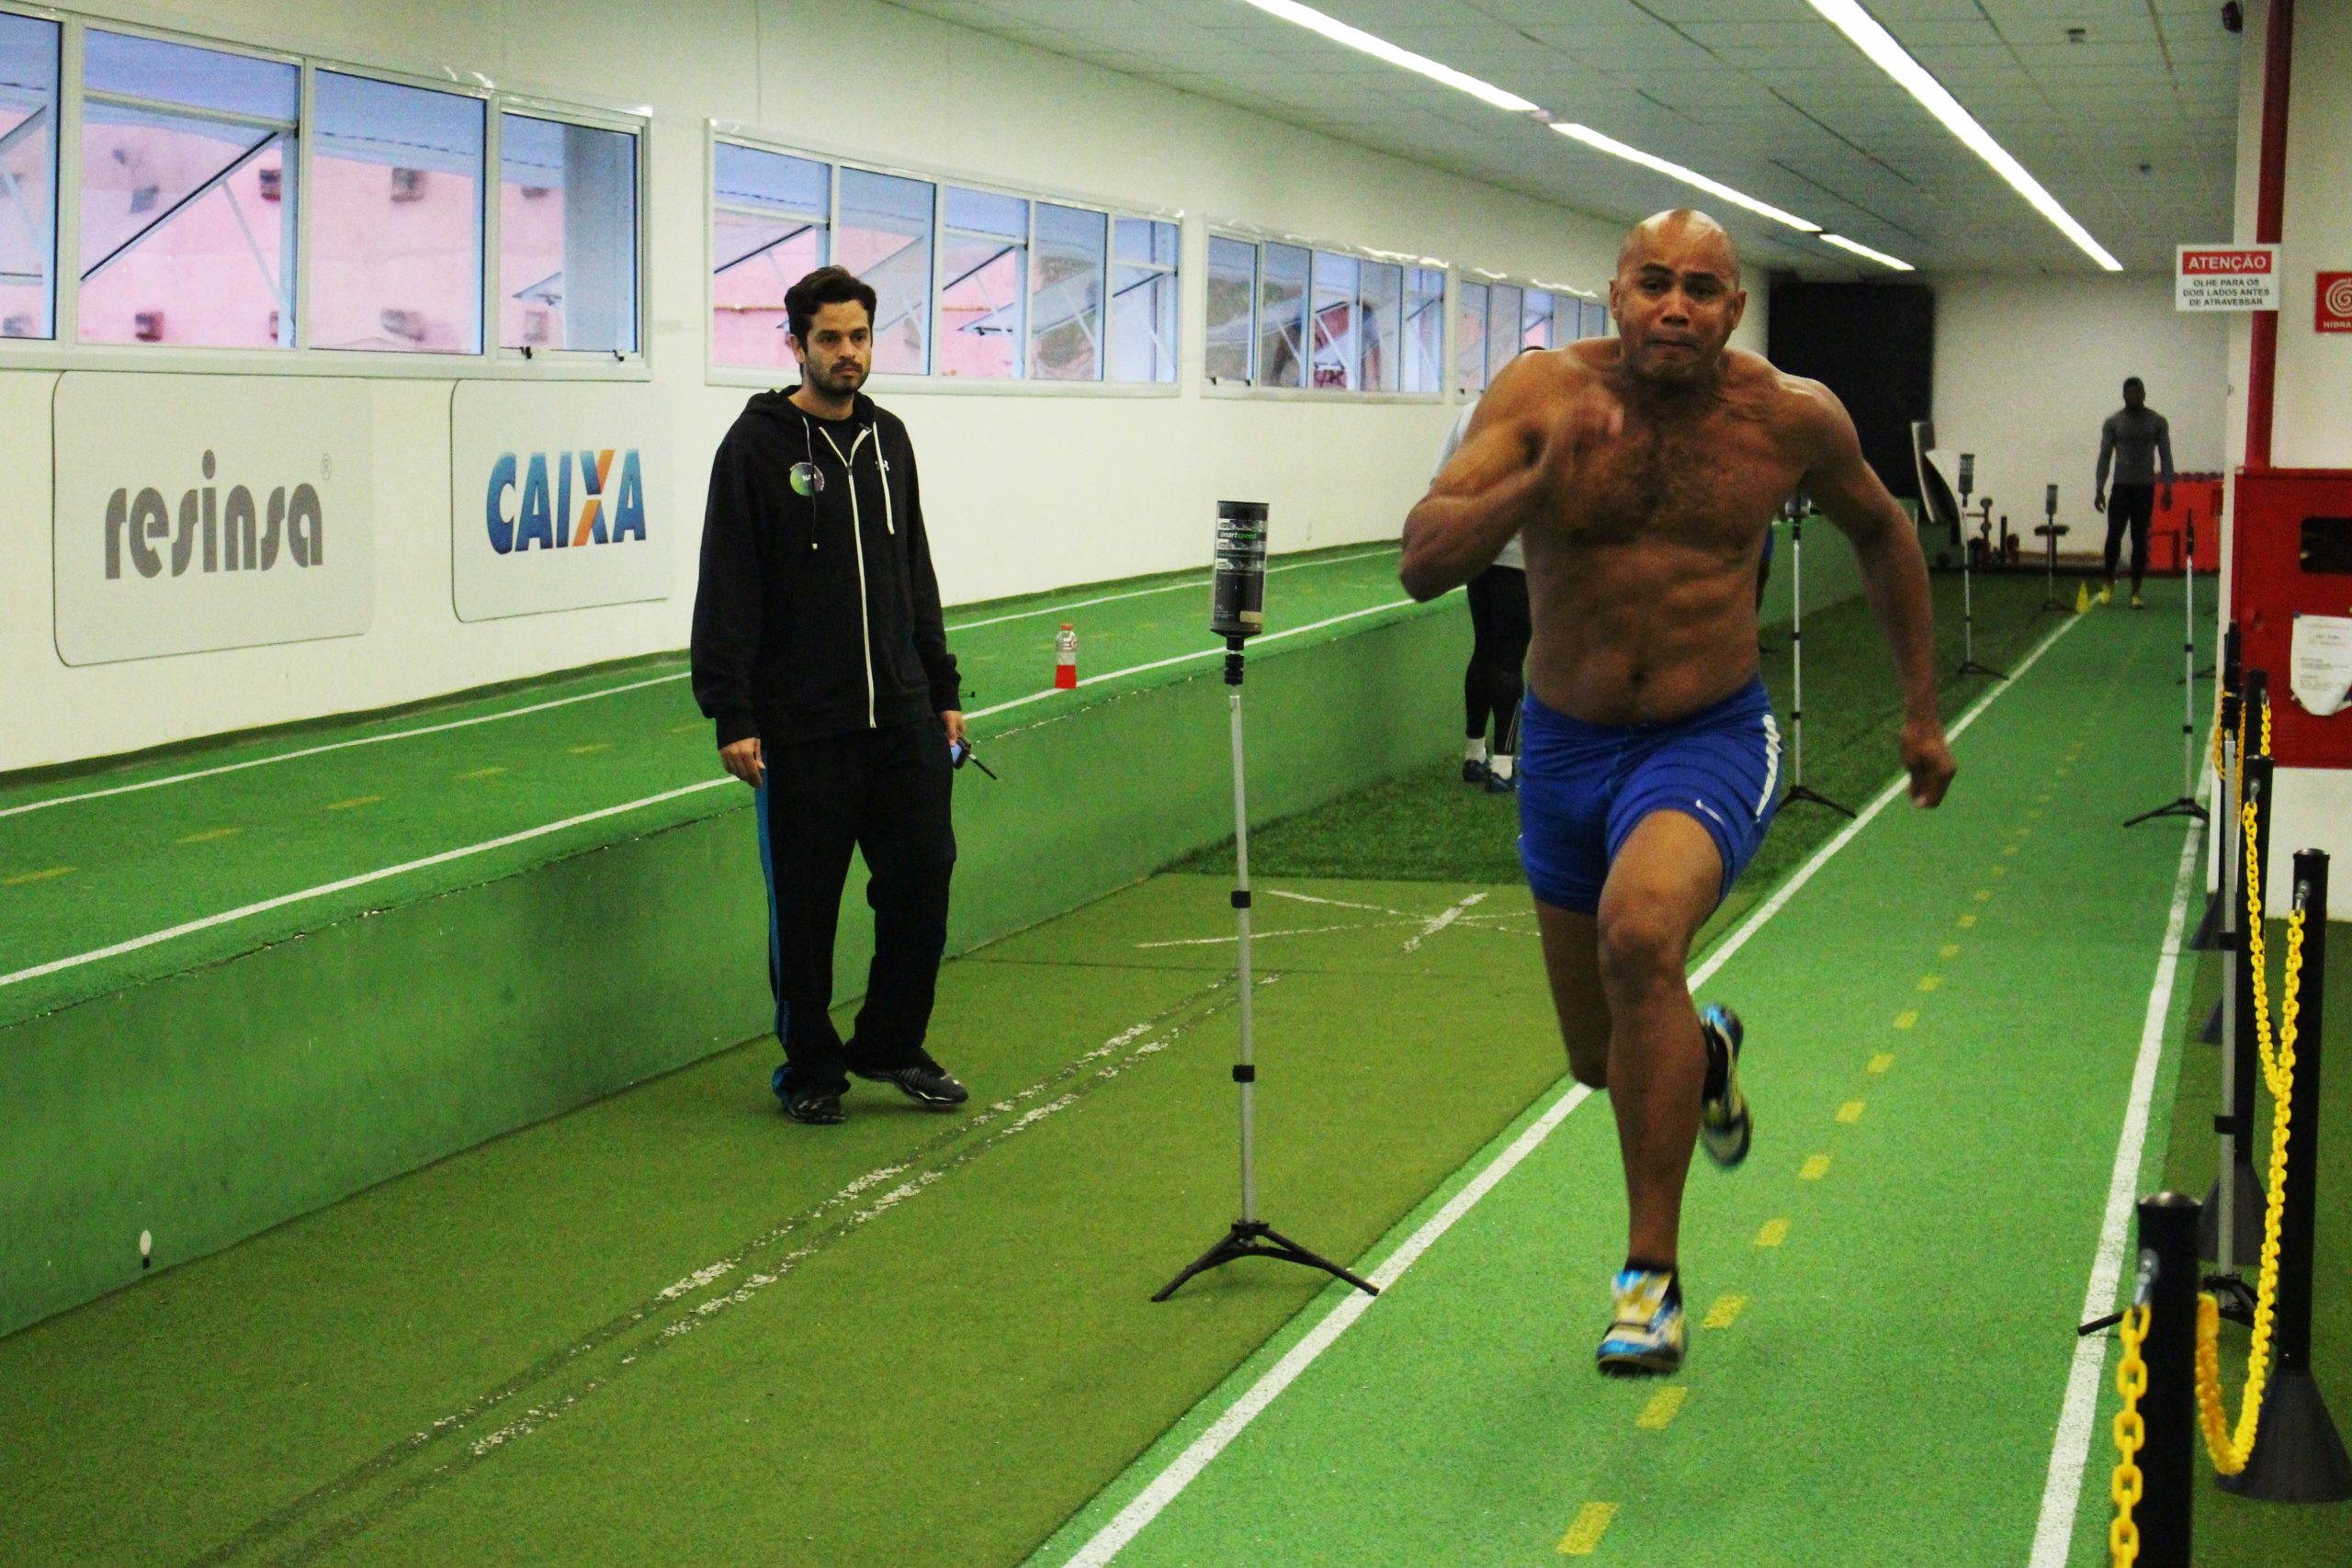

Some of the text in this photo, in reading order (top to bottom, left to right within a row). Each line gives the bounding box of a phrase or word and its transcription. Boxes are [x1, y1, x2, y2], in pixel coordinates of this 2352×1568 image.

[2188, 254, 2267, 273] ATENÇÃO
[2220, 278, 2245, 287] PARA
[2246, 278, 2260, 287] OS
[2207, 288, 2238, 297] LADOS
[2240, 288, 2270, 296] ANTES
[2203, 298, 2264, 306] ATRAVESSAR
[486, 449, 647, 556] CAIXA
[105, 449, 323, 580] resinsa
